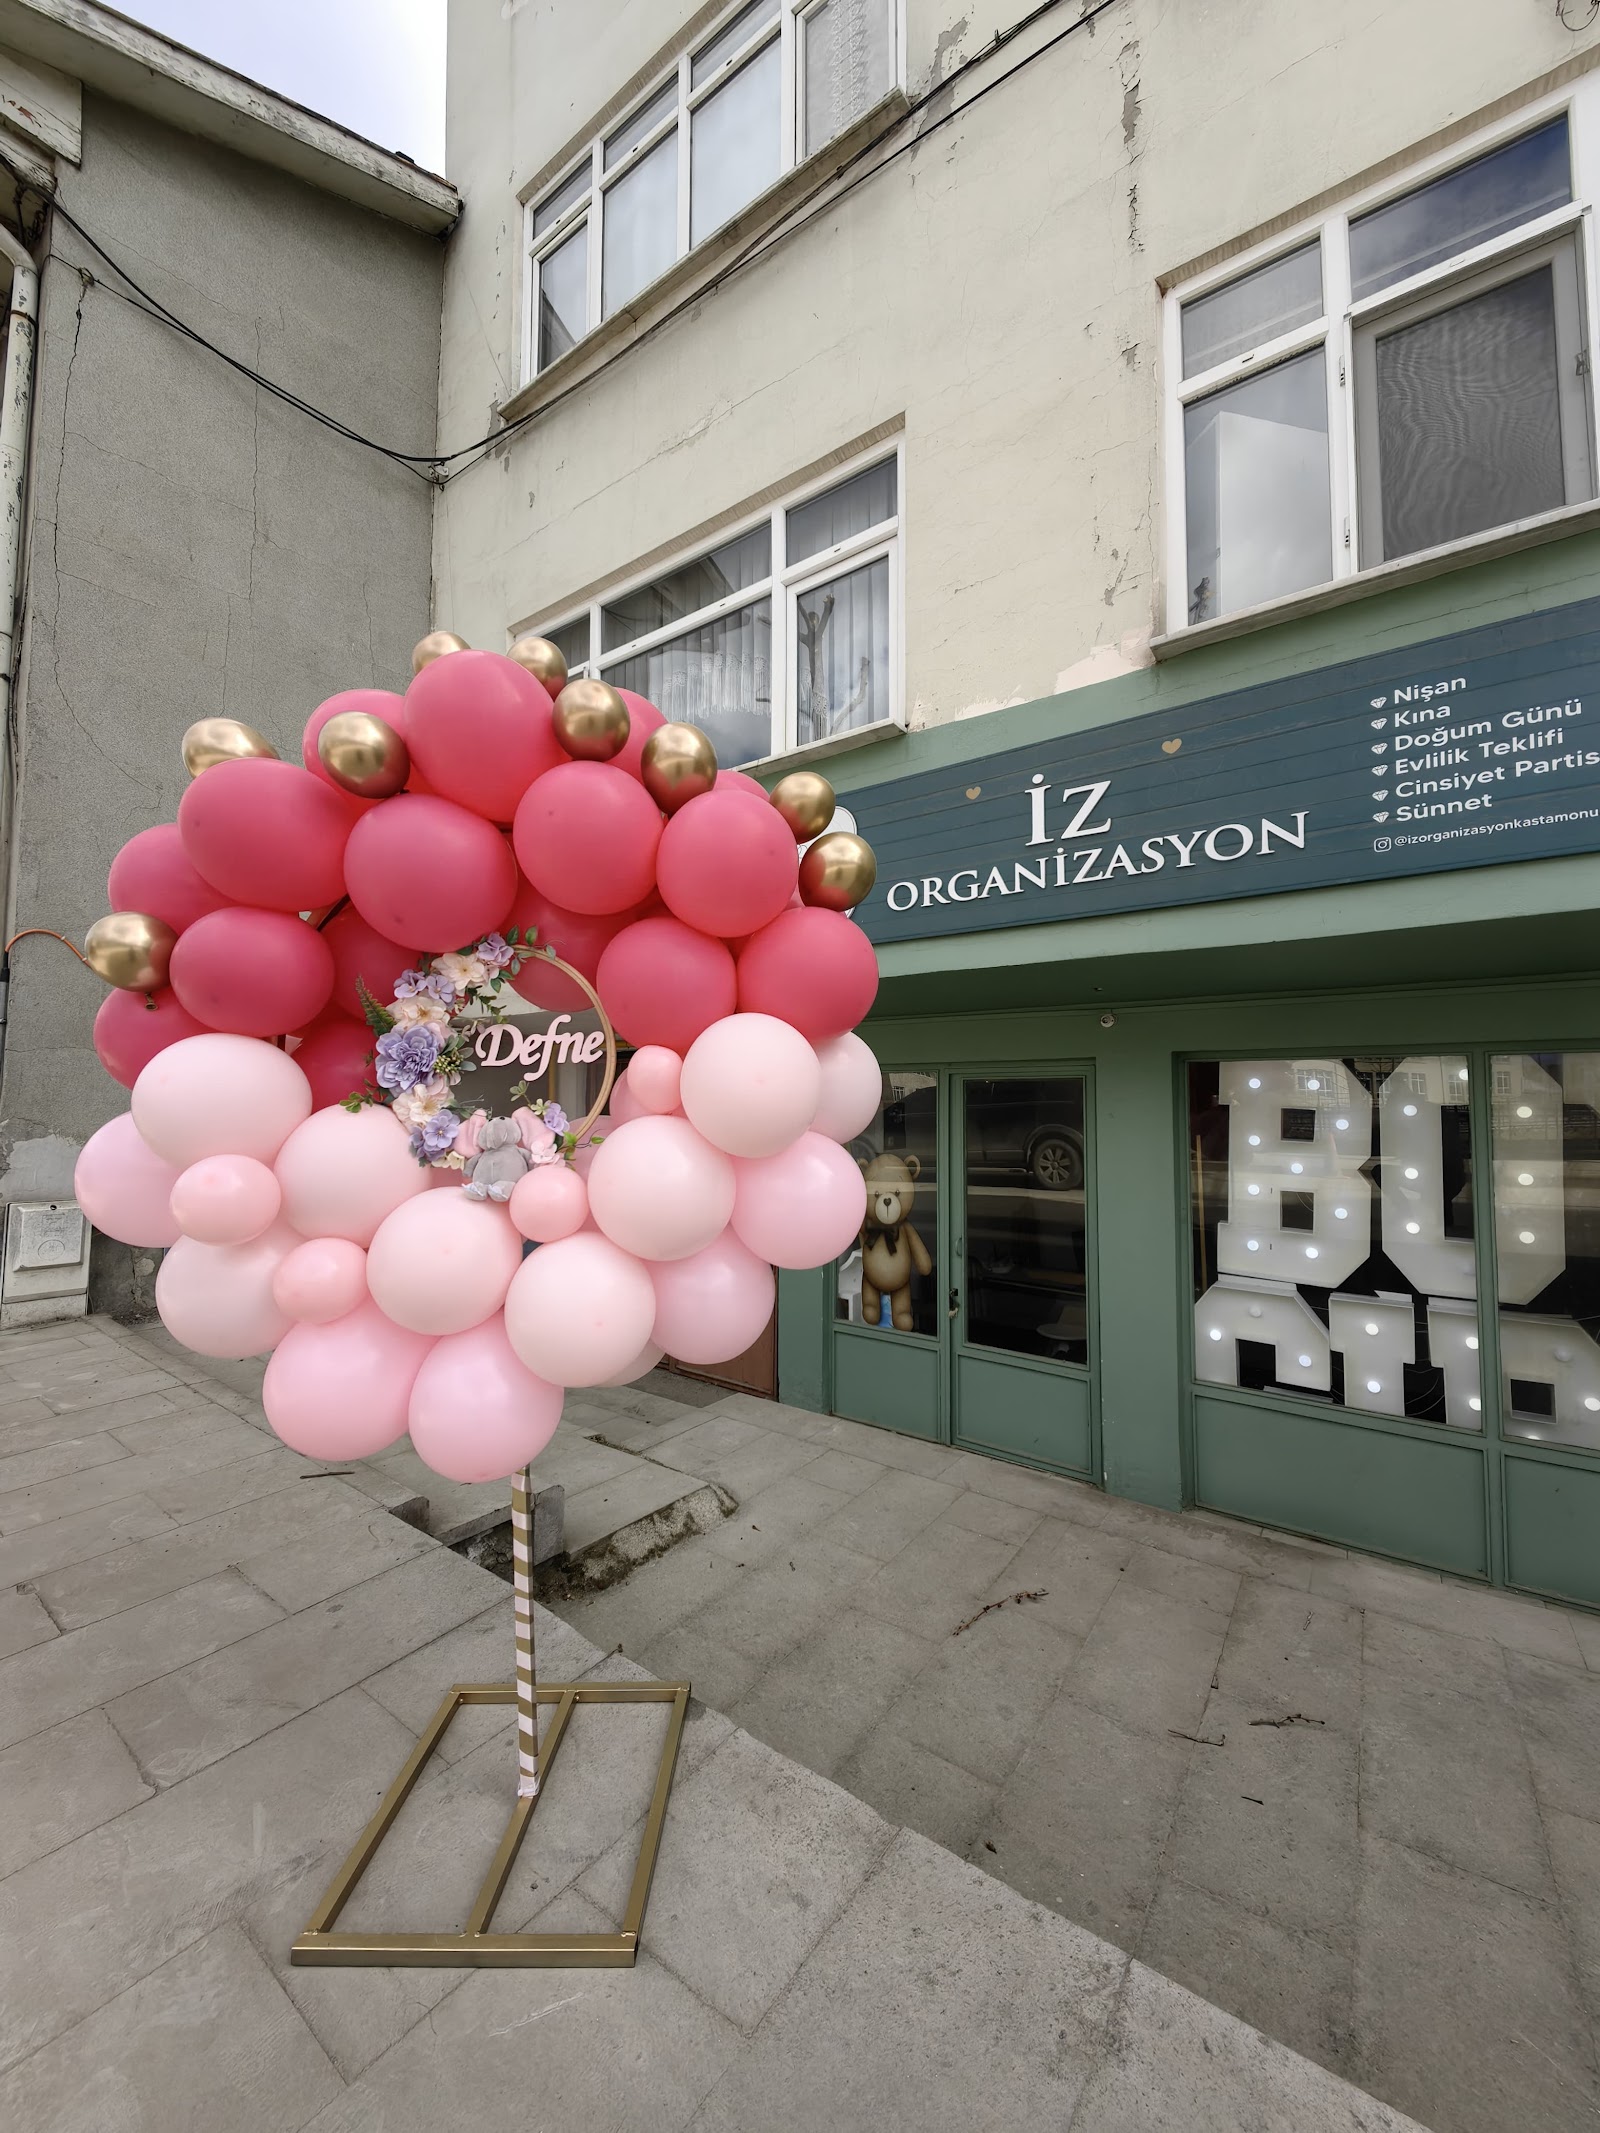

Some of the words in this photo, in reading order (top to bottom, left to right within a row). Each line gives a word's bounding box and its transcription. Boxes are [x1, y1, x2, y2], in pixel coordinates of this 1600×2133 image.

[1394, 677, 1467, 704] Nişan
[1394, 705, 1451, 728] Kına
[1395, 721, 1492, 751] Doğum
[1501, 698, 1582, 728] Günü
[1395, 748, 1470, 775] Evlilik
[1478, 728, 1564, 758] Teklifi
[1395, 766, 1506, 798] Cinsiyet
[1515, 750, 1600, 777] Partis
[1024, 773, 1112, 846] İZ
[1394, 808, 1599, 847] @izorganizasyonkastamonu
[1396, 794, 1493, 822] Sünnet
[886, 810, 1310, 912] ORGANİZASYON
[475, 1014, 605, 1082] Defne
